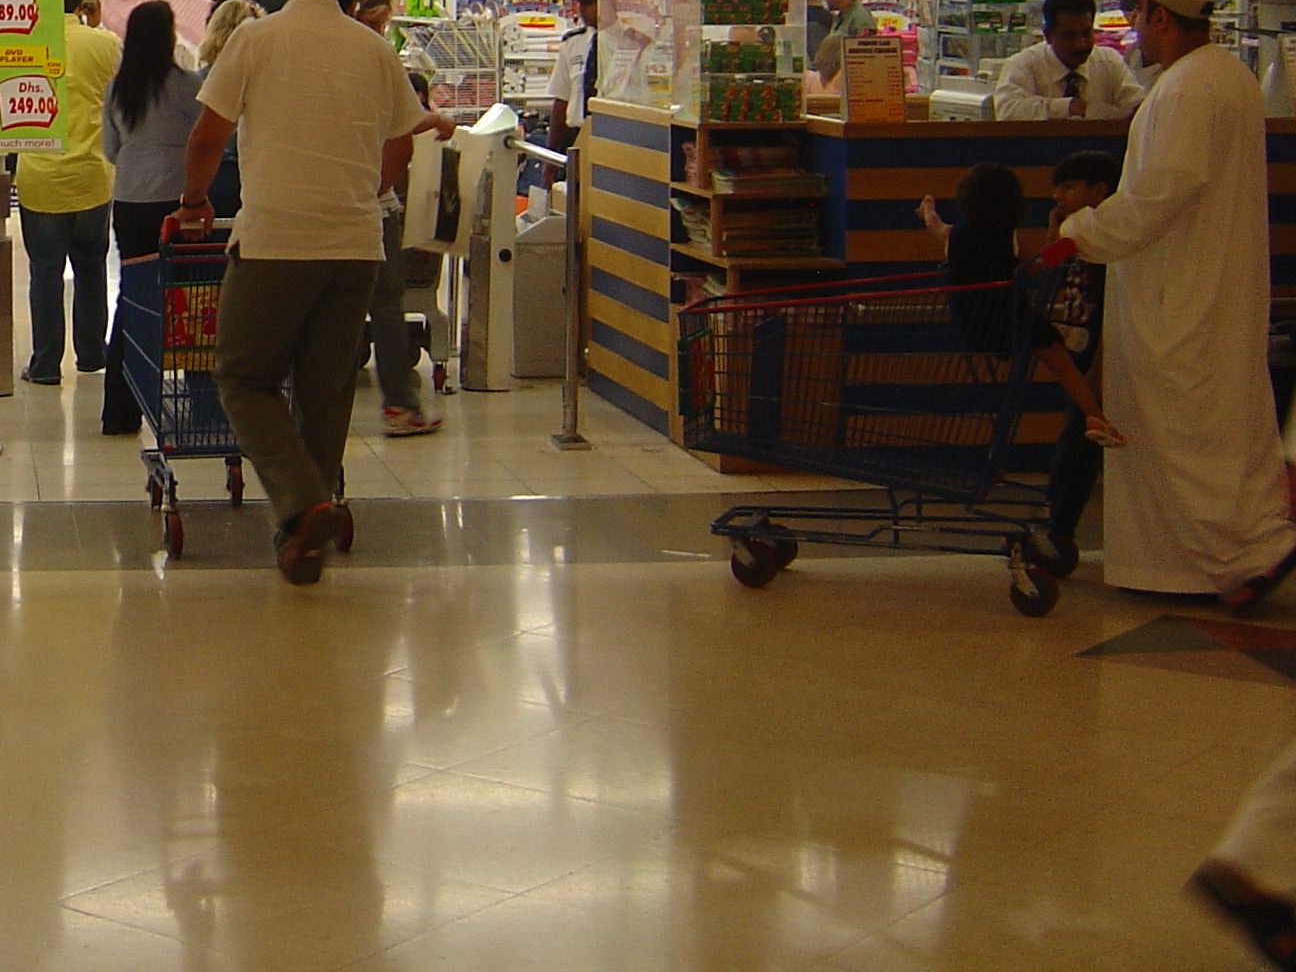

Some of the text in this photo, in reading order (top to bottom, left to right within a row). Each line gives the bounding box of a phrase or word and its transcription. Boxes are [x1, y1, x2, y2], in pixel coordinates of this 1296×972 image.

[19, 82, 44, 93] Dhs.
[9, 97, 54, 114] 249.00
[25, 139, 54, 147] more!
